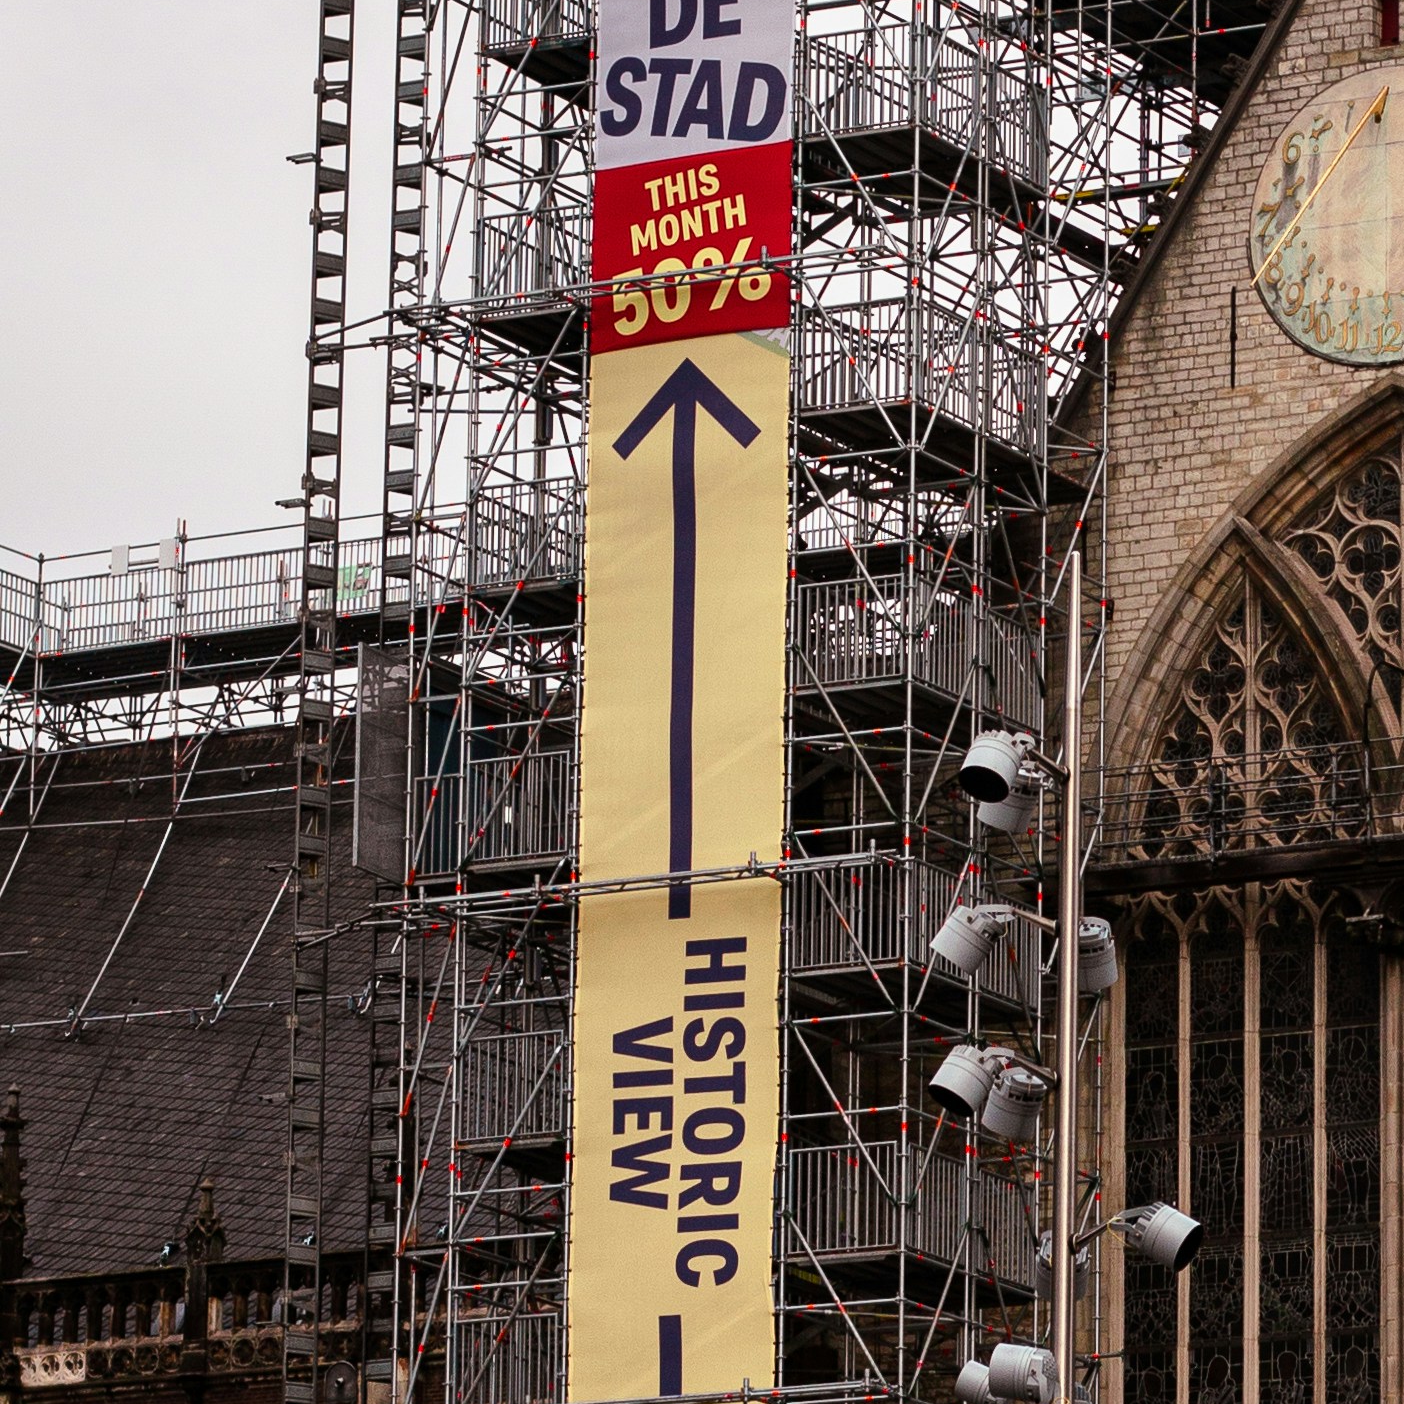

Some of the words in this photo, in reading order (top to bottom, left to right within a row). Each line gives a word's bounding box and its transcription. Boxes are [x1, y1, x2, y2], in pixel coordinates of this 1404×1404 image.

[600, 55, 787, 142] STAD
[1281, 131, 1305, 165] 6
[644, 163, 720, 211] THIS
[630, 194, 748, 256] MONTH
[1256, 200, 1281, 237] 7
[612, 236, 772, 337] 50%
[1264, 250, 1284, 284] 8
[1282, 281, 1305, 317] 9
[1302, 299, 1333, 344] 10
[1337, 316, 1359, 353] 11
[1370, 320, 1402, 356] 12
[609, 1016, 674, 1211] VIEW
[675, 936, 748, 1288] HISTORIC
